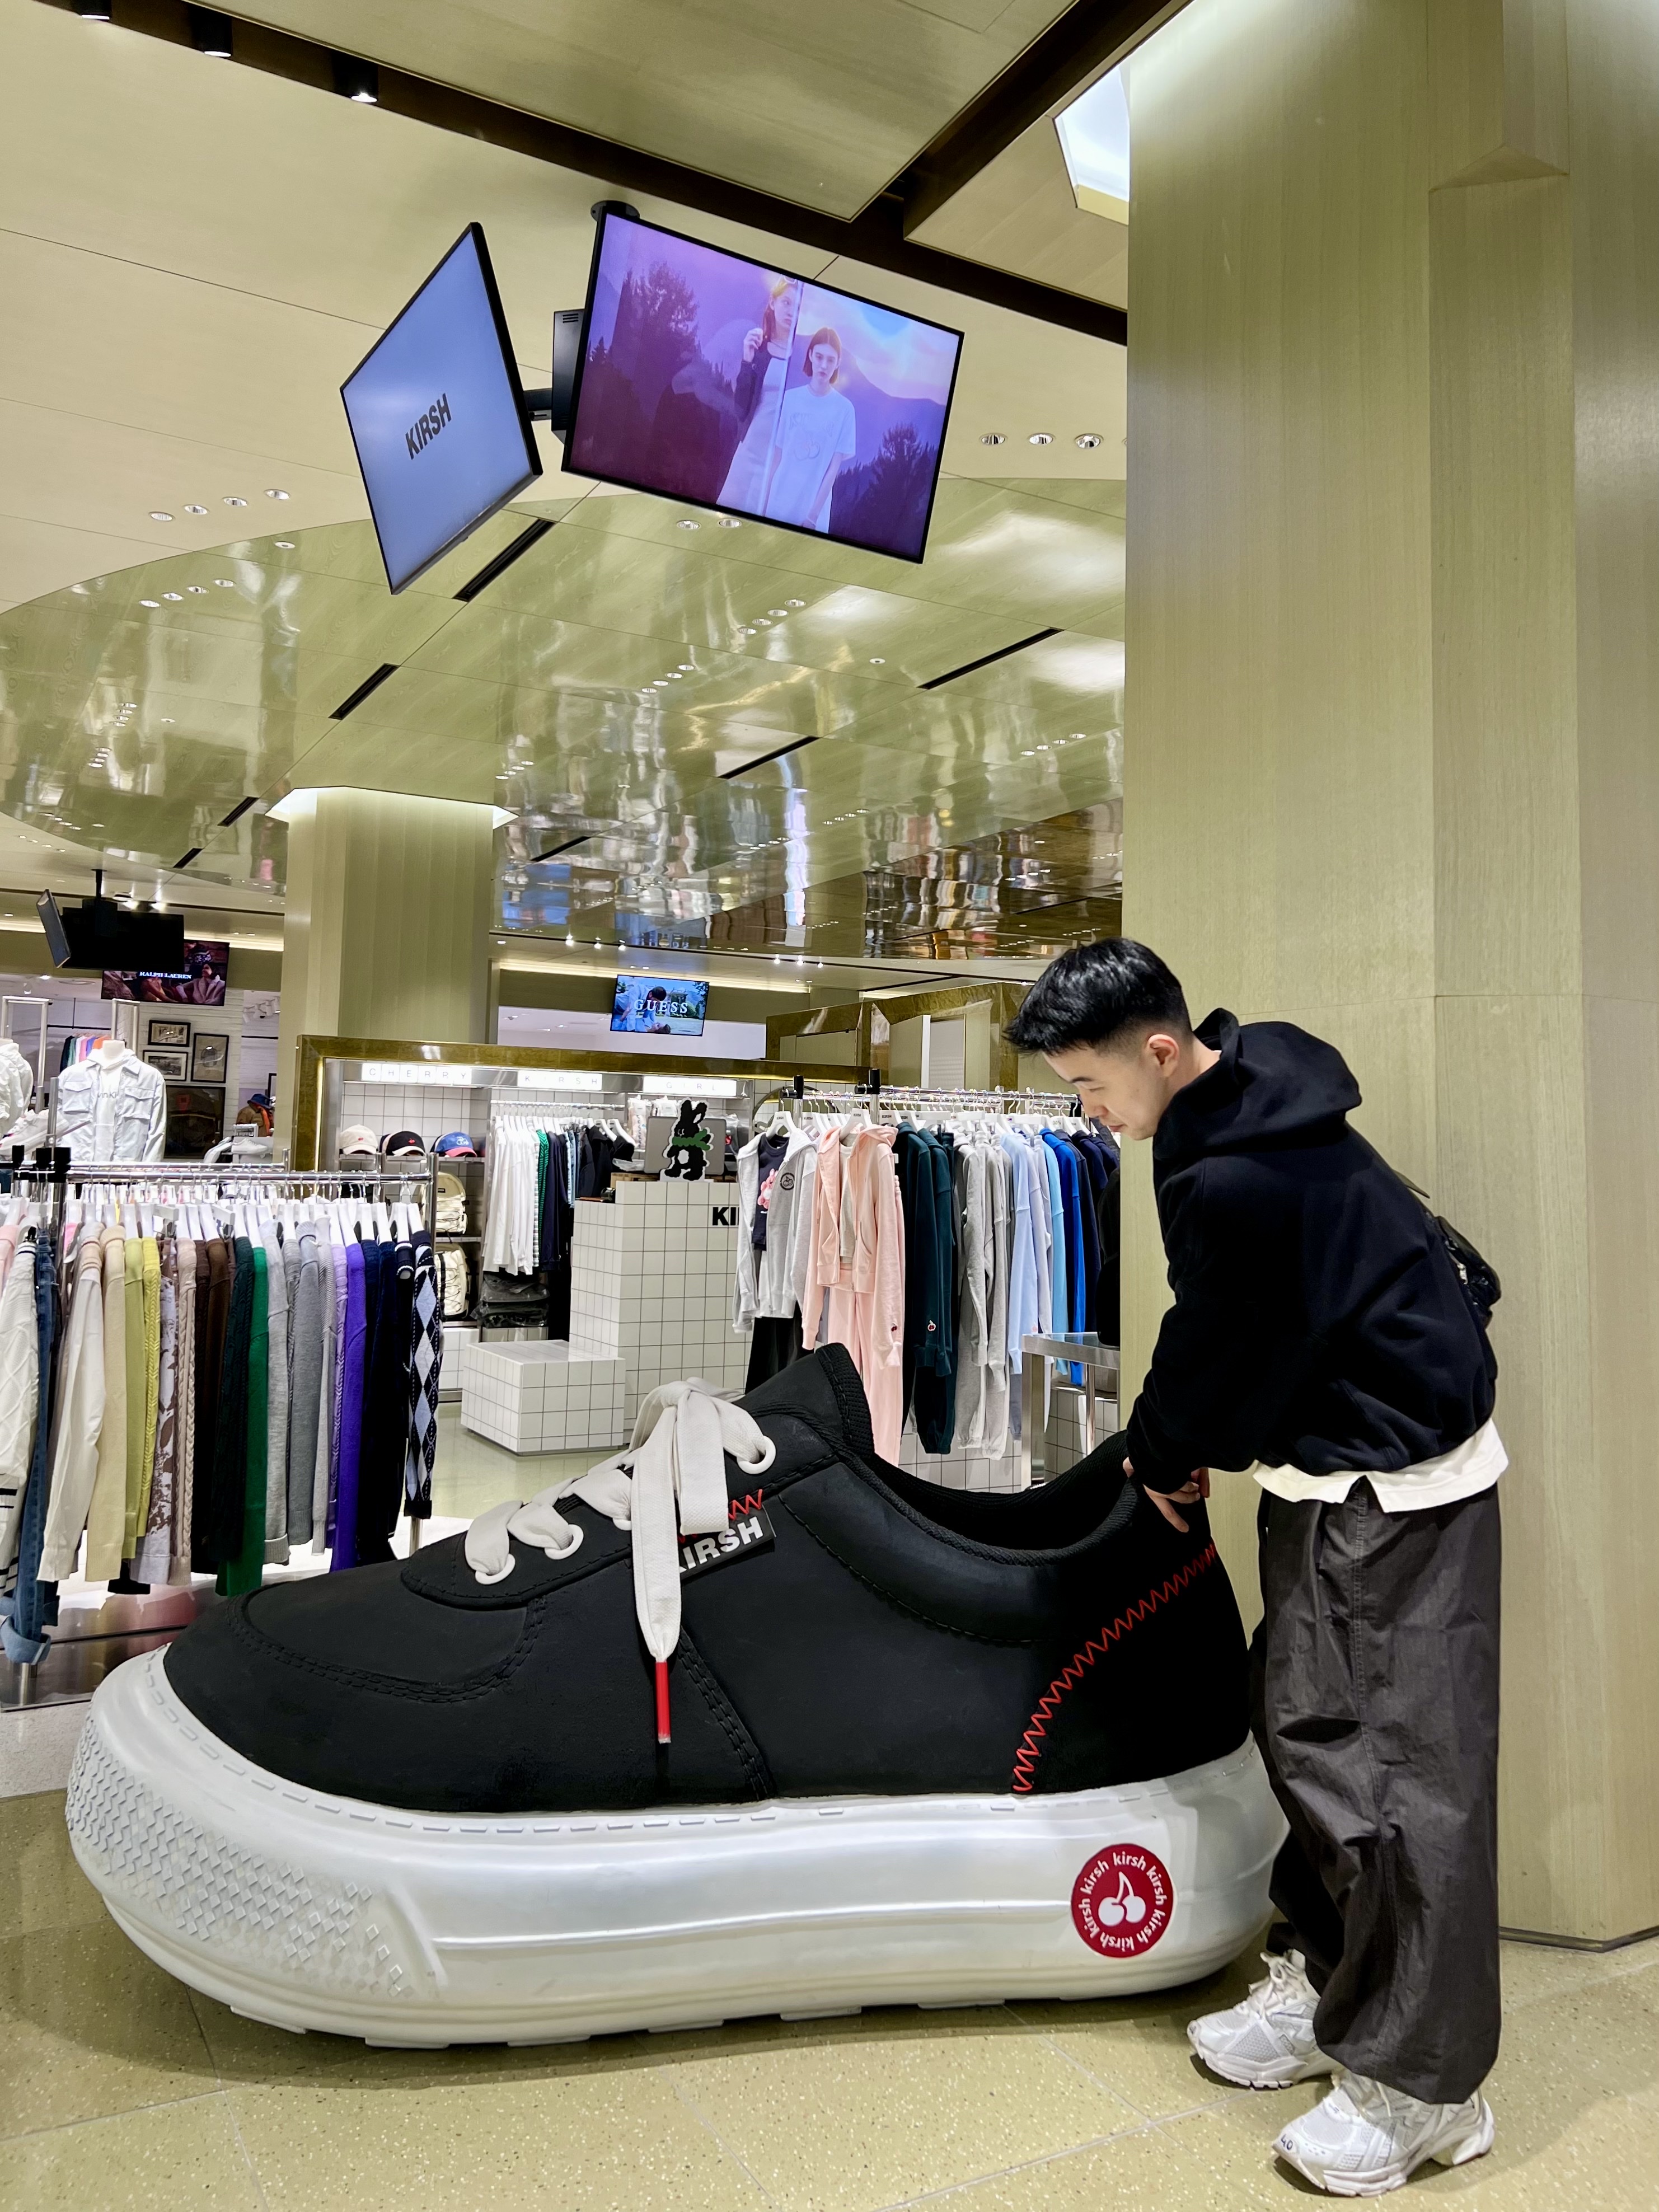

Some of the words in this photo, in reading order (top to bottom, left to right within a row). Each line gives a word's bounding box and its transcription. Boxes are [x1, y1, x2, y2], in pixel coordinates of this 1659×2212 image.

[405, 393, 451, 460] KIRSH
[634, 999, 688, 1014] GUESS
[369, 1068, 466, 1079] CHERRY
[524, 1076, 597, 1085] KIRSH
[666, 1081, 716, 1091] GIRL
[712, 1207, 739, 1226] KI
[679, 1516, 763, 1573] IRSH
[1112, 1850, 1147, 1871] kirsh
[1080, 1860, 1110, 1895] kirsh
[1146, 1865, 1168, 1906] kirsh
[1078, 1898, 1100, 1939] kirsh
[1136, 1909, 1166, 1943] kirsh
[1100, 1932, 1135, 1952] kirsh
[1280, 2133, 1294, 2150] 40
